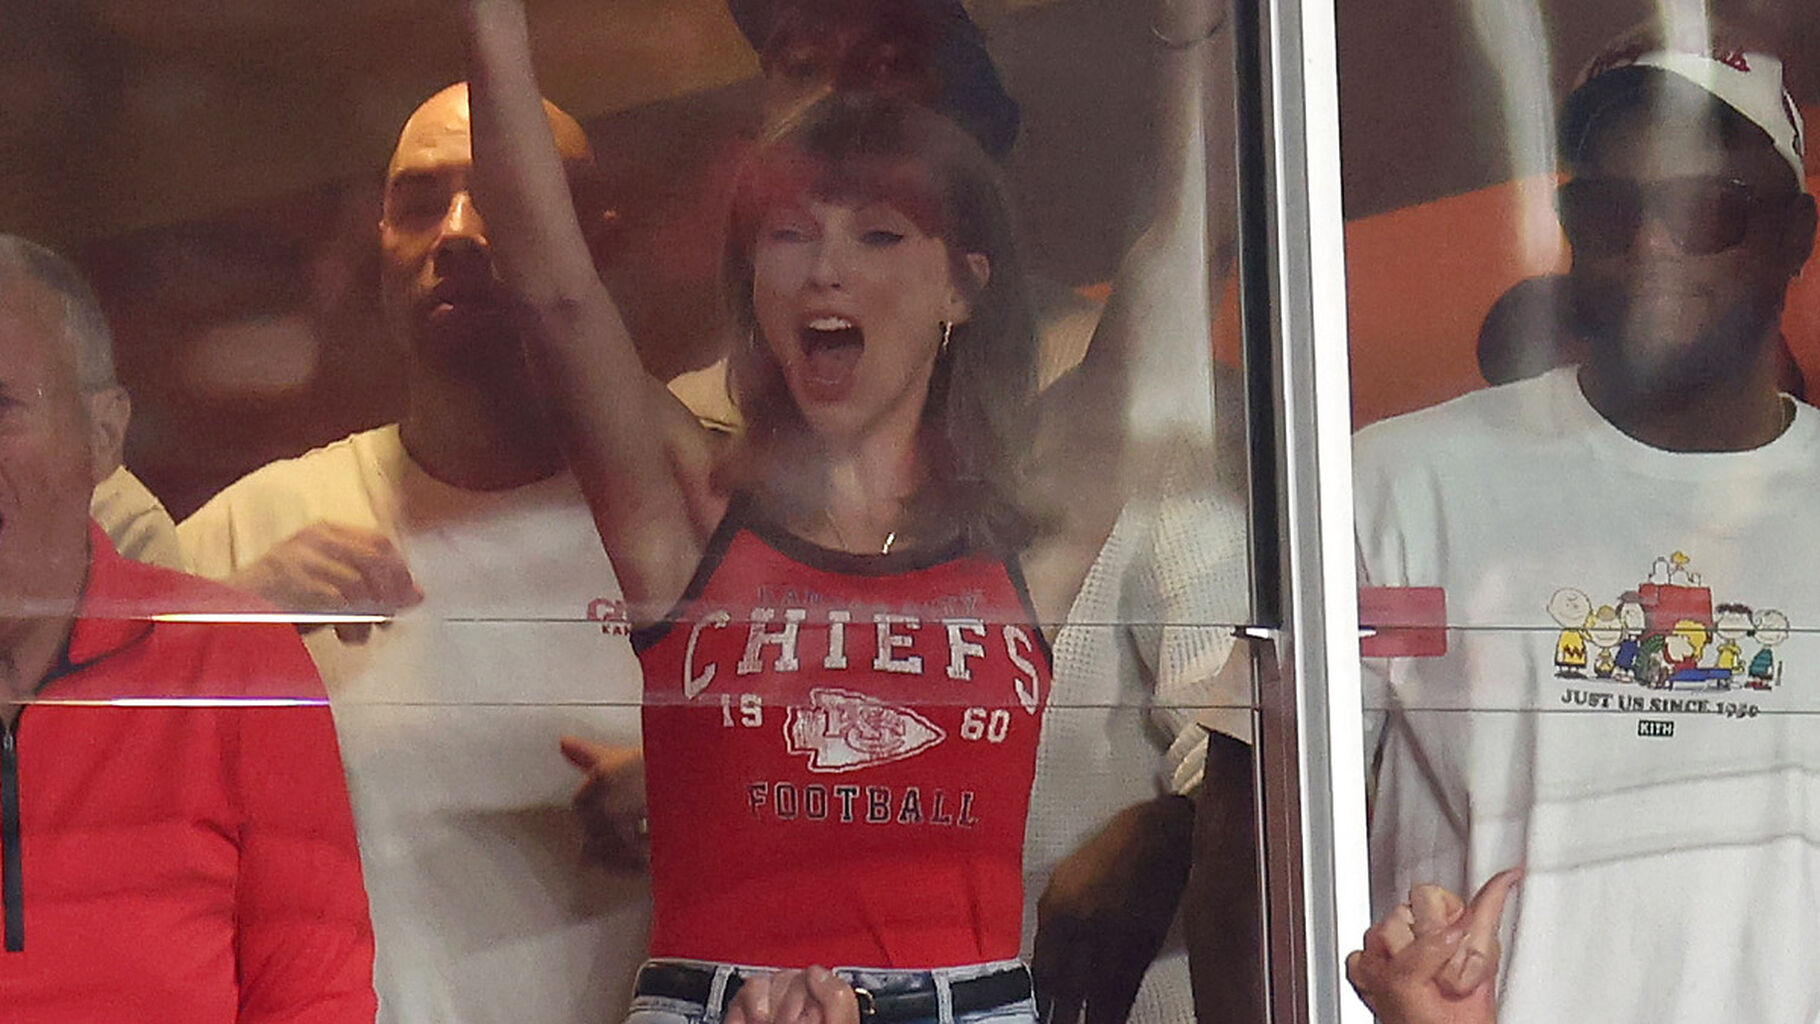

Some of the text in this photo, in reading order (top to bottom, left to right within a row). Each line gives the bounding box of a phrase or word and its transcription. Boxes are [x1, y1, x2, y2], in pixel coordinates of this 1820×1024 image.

[684, 607, 1041, 715] CHIEFS
[720, 694, 1011, 742] 19 60
[1561, 688, 1613, 708] JUST
[1618, 694, 1644, 712] US
[1649, 697, 1710, 713] SINCE
[1639, 721, 1674, 735] KITH
[748, 781, 978, 828] FOOTBALL
